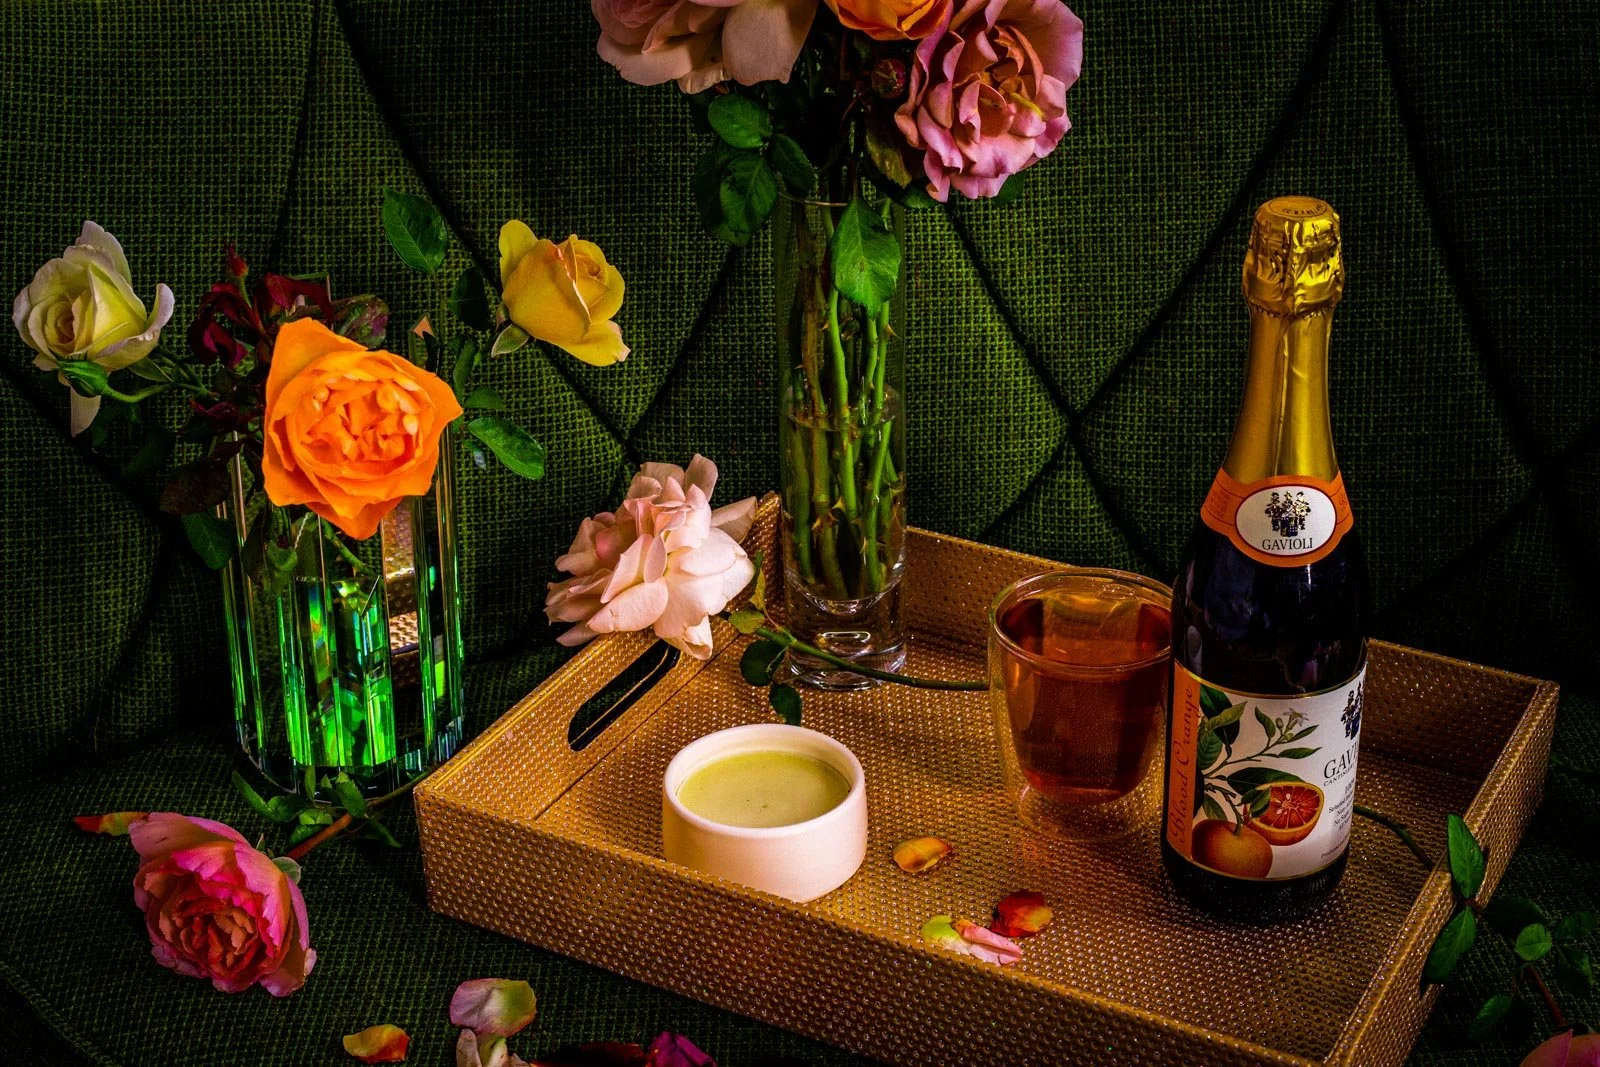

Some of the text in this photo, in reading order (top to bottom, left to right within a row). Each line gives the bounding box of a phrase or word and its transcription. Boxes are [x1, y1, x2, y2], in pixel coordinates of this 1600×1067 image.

[1262, 537, 1313, 550] GAVIOLI
[1169, 687, 1202, 844] Blood Orange
[1323, 741, 1358, 779] GAVI
